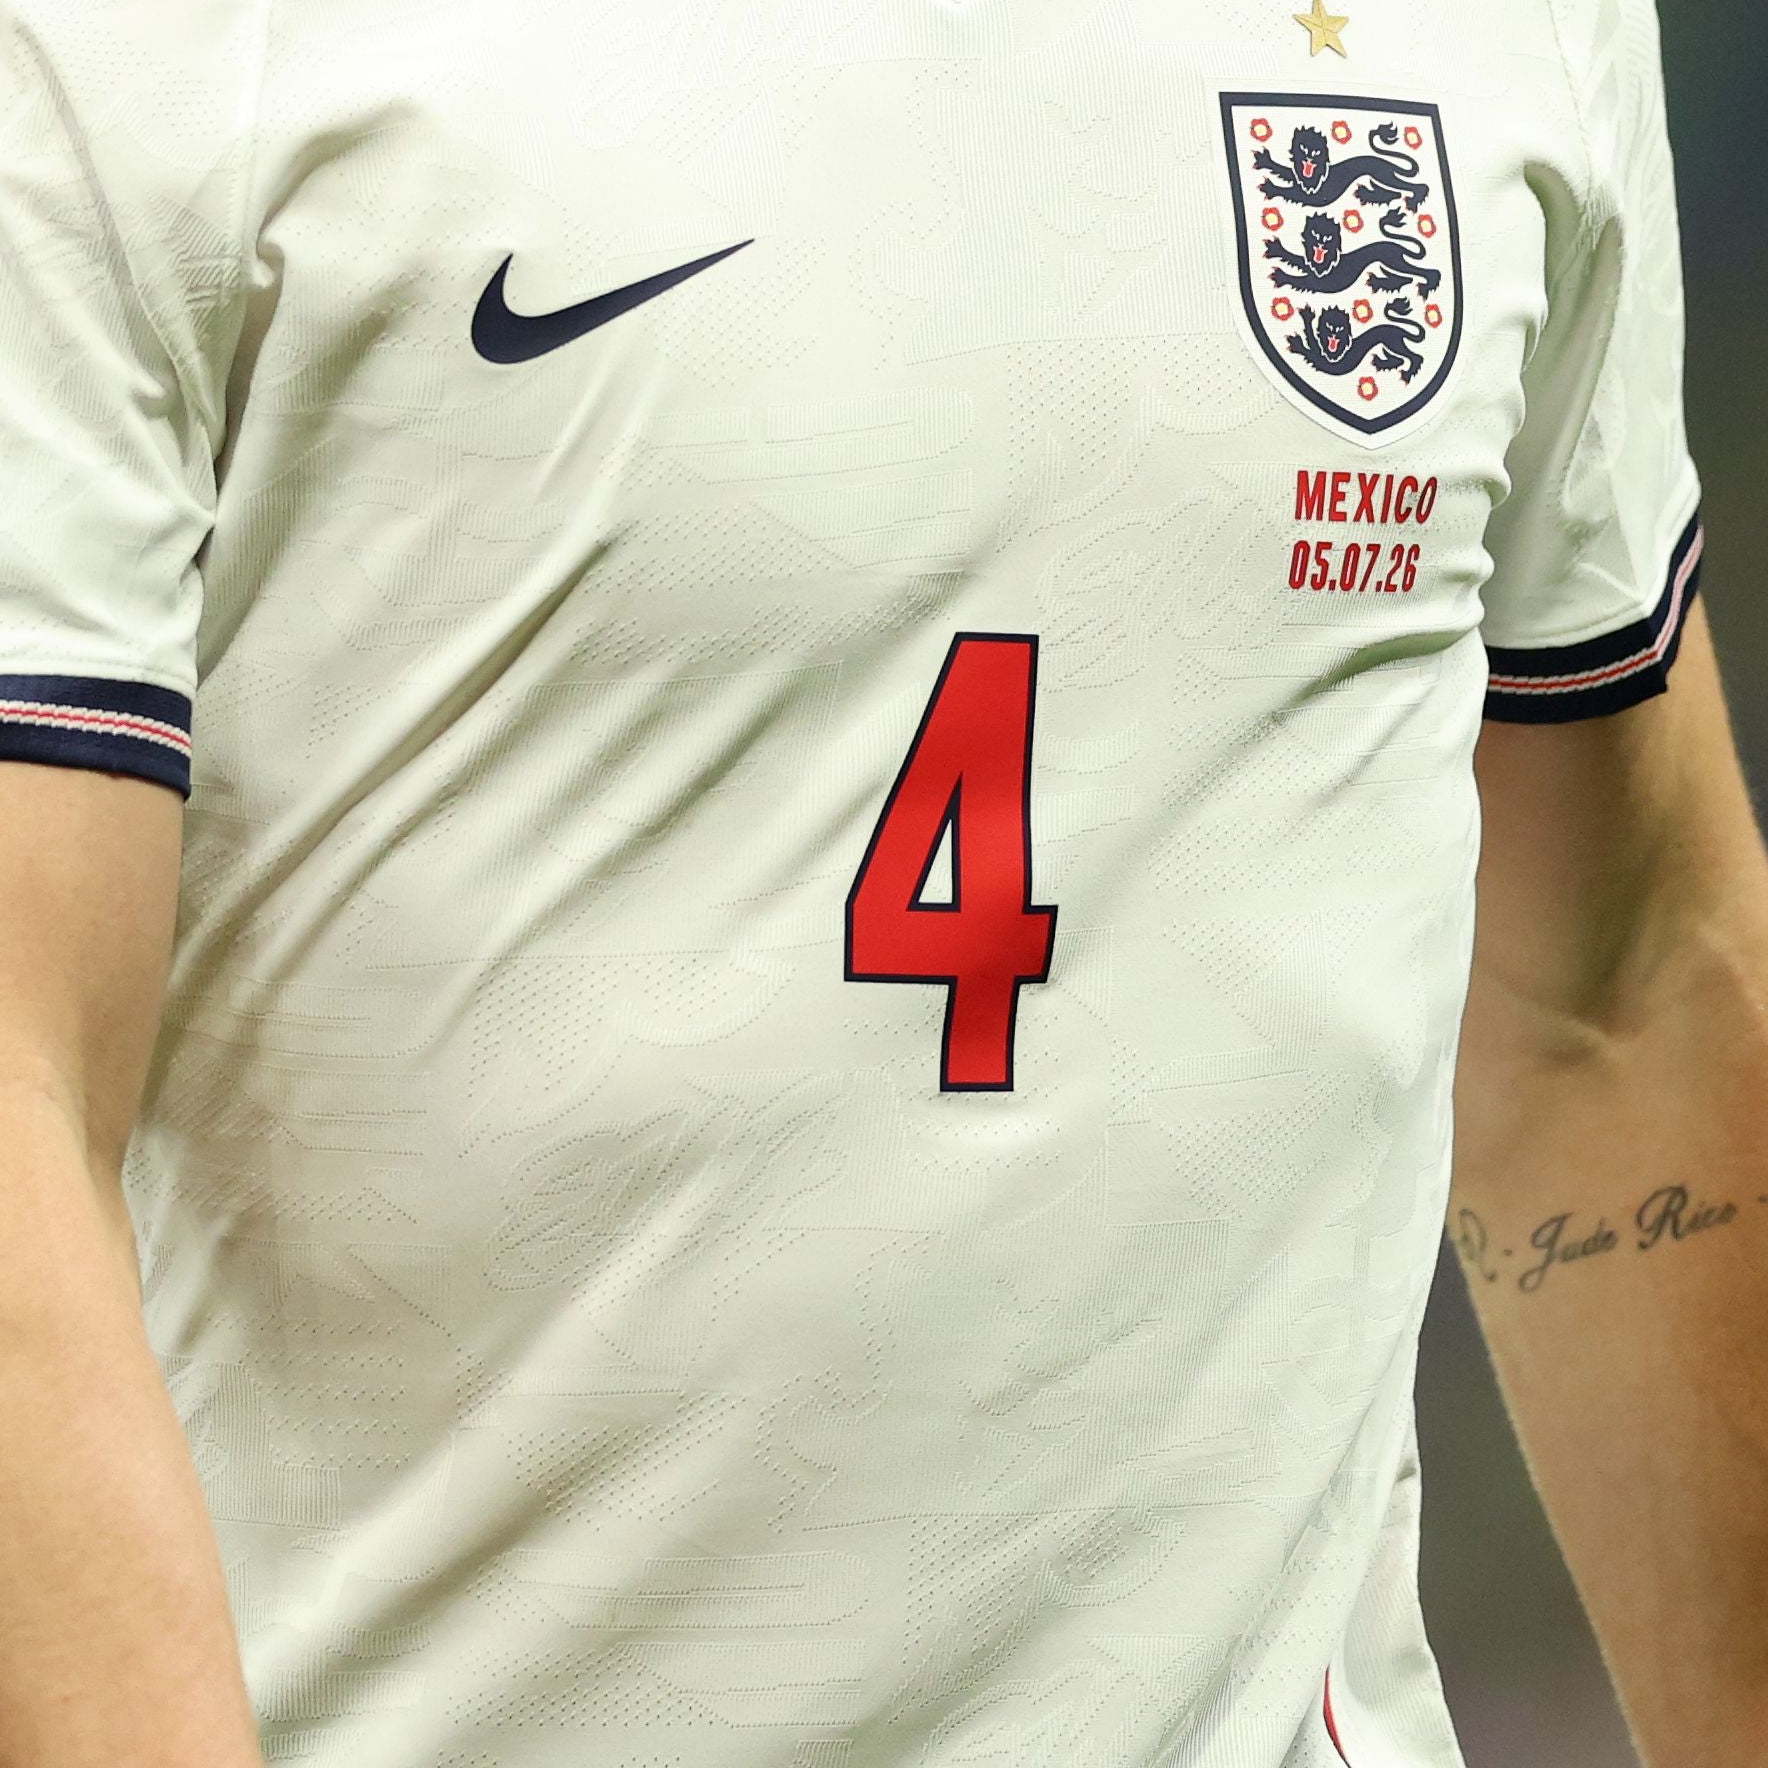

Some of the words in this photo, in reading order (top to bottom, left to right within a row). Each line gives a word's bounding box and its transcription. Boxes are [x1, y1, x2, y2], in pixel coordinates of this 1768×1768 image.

[1294, 470, 1438, 524] MEXICO
[1288, 540, 1421, 593] 05.07.26
[843, 632, 1059, 1092] 4
